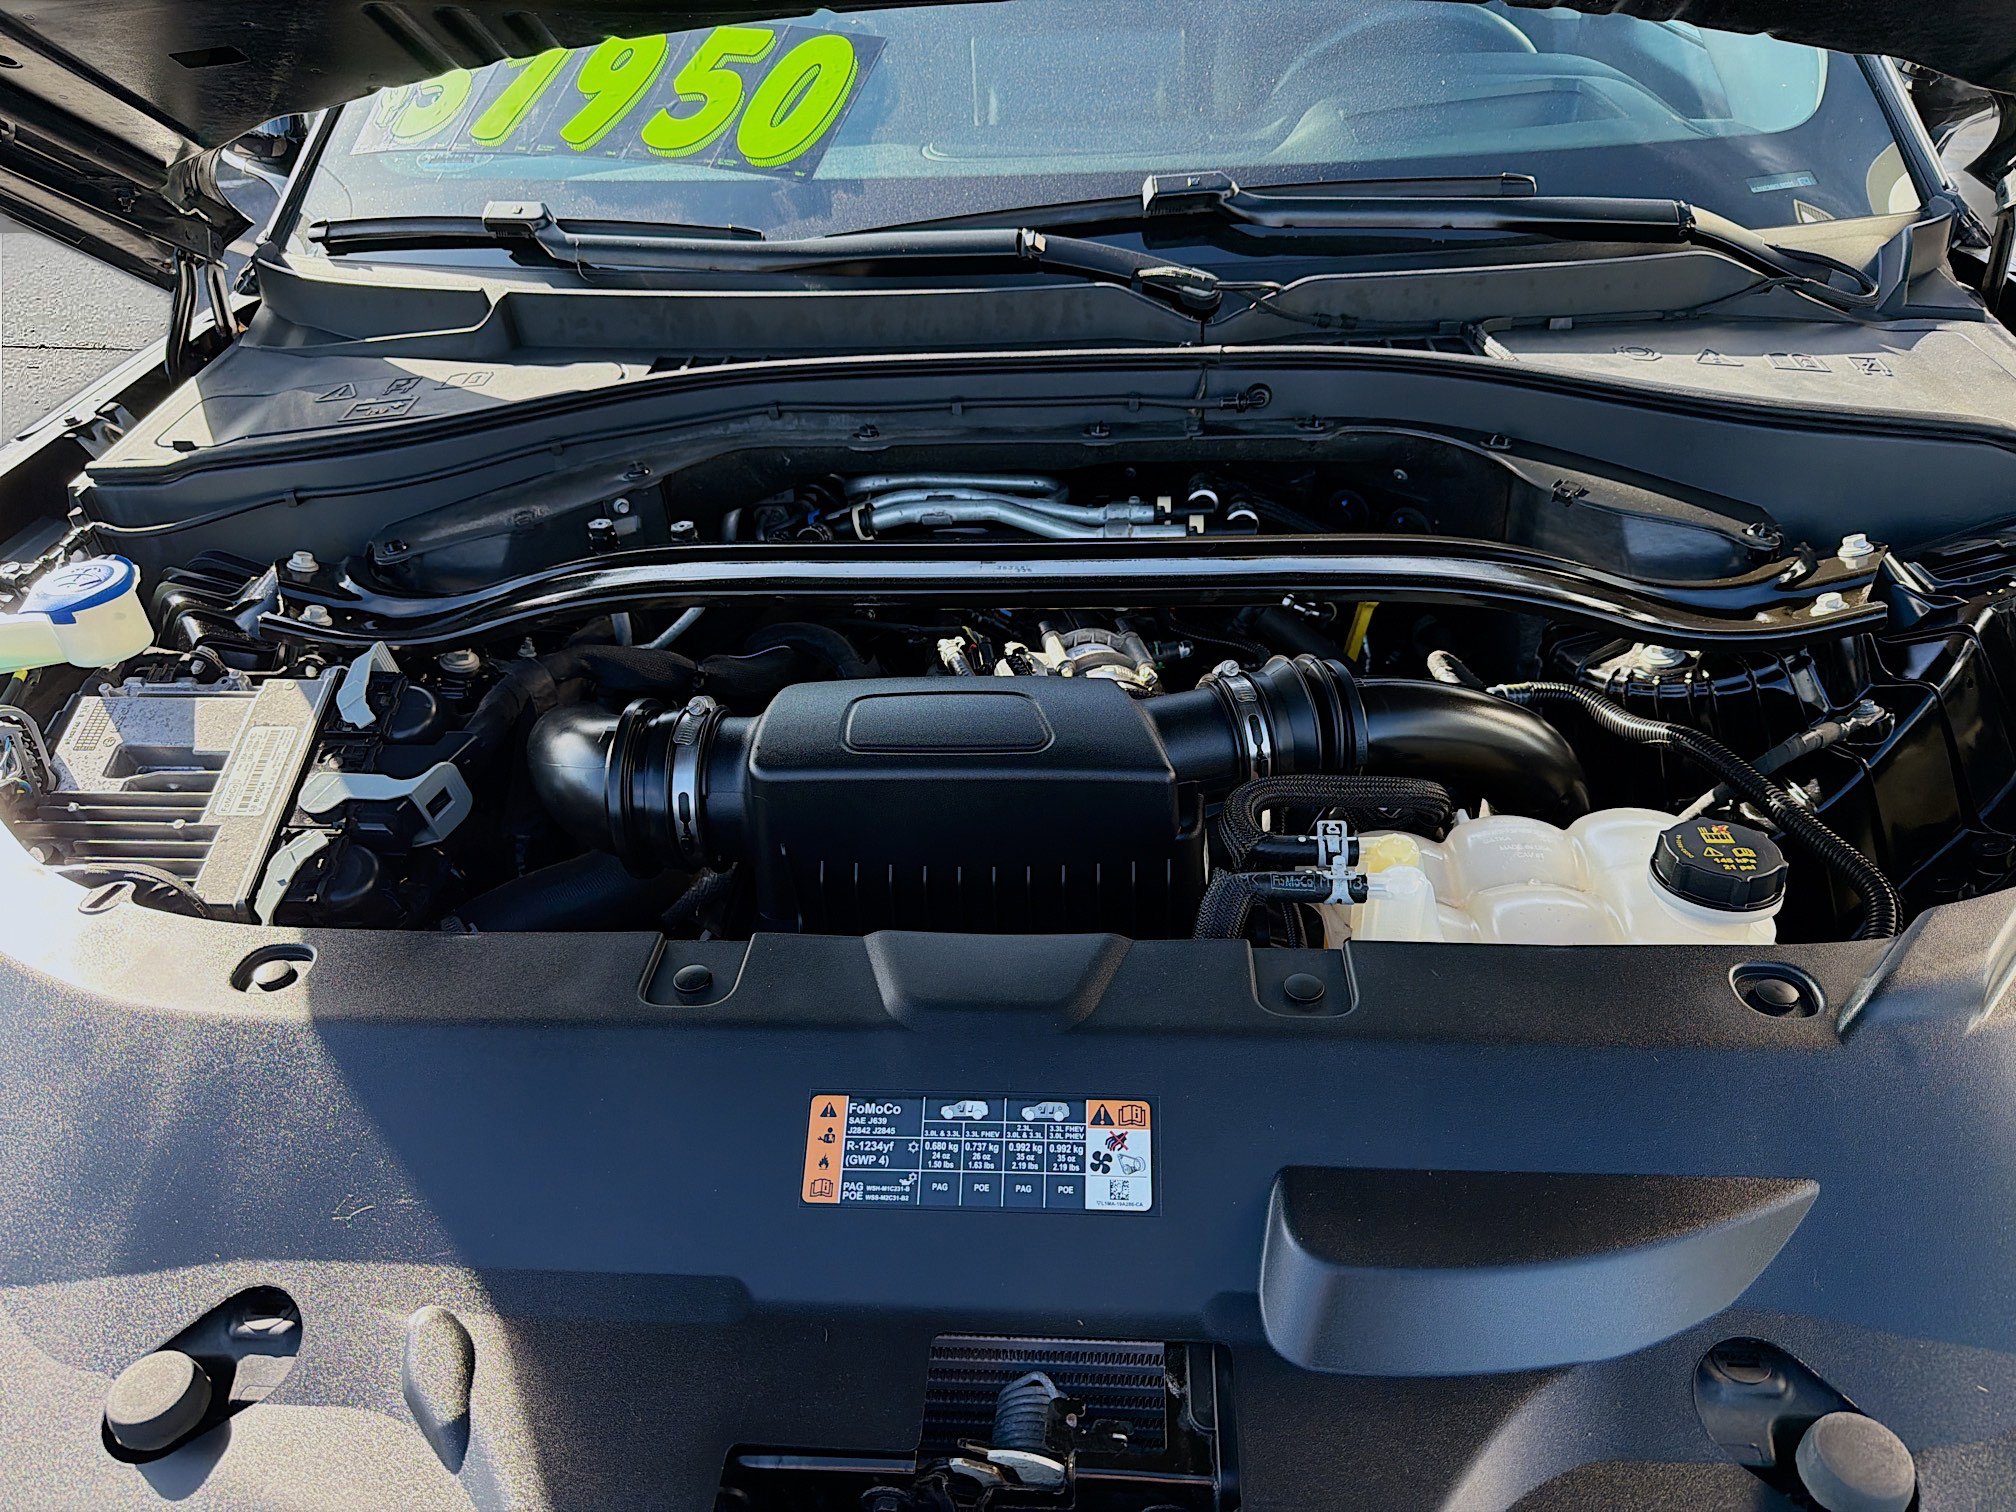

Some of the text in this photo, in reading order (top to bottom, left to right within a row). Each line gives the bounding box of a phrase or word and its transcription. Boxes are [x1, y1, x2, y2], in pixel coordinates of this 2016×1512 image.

[1272, 875, 1314, 888] FoMoCo
[848, 1102, 902, 1115] FoMoCo
[848, 1116, 888, 1125] SAE J639
[847, 1126, 896, 1135] J2842 J2845
[846, 1140, 895, 1154] R-1234yf
[924, 1141, 959, 1153] 0.680 kg
[965, 1142, 999, 1154] 0.737 kg
[1008, 1142, 1043, 1154] 0.992 kg
[1049, 1144, 1084, 1155] 0.992 kg
[931, 1151, 940, 1160] 24
[972, 1152, 981, 1160] 26
[1016, 1153, 1025, 1161] 35
[1057, 1154, 1066, 1162] 35
[845, 1154, 890, 1168] (GWP 4)
[927, 1160, 954, 1169] 1.50 lbs
[968, 1161, 995, 1169] 1.63 lbs
[1011, 1161, 1039, 1170] 2.19 lbs
[1052, 1163, 1080, 1172] 2.19 lbs
[843, 1181, 864, 1191] PAG
[931, 1182, 949, 1191] PAG
[973, 1183, 990, 1192] POE
[1015, 1184, 1032, 1193] PAG
[1057, 1185, 1074, 1194] POE
[842, 1191, 864, 1201] POE
